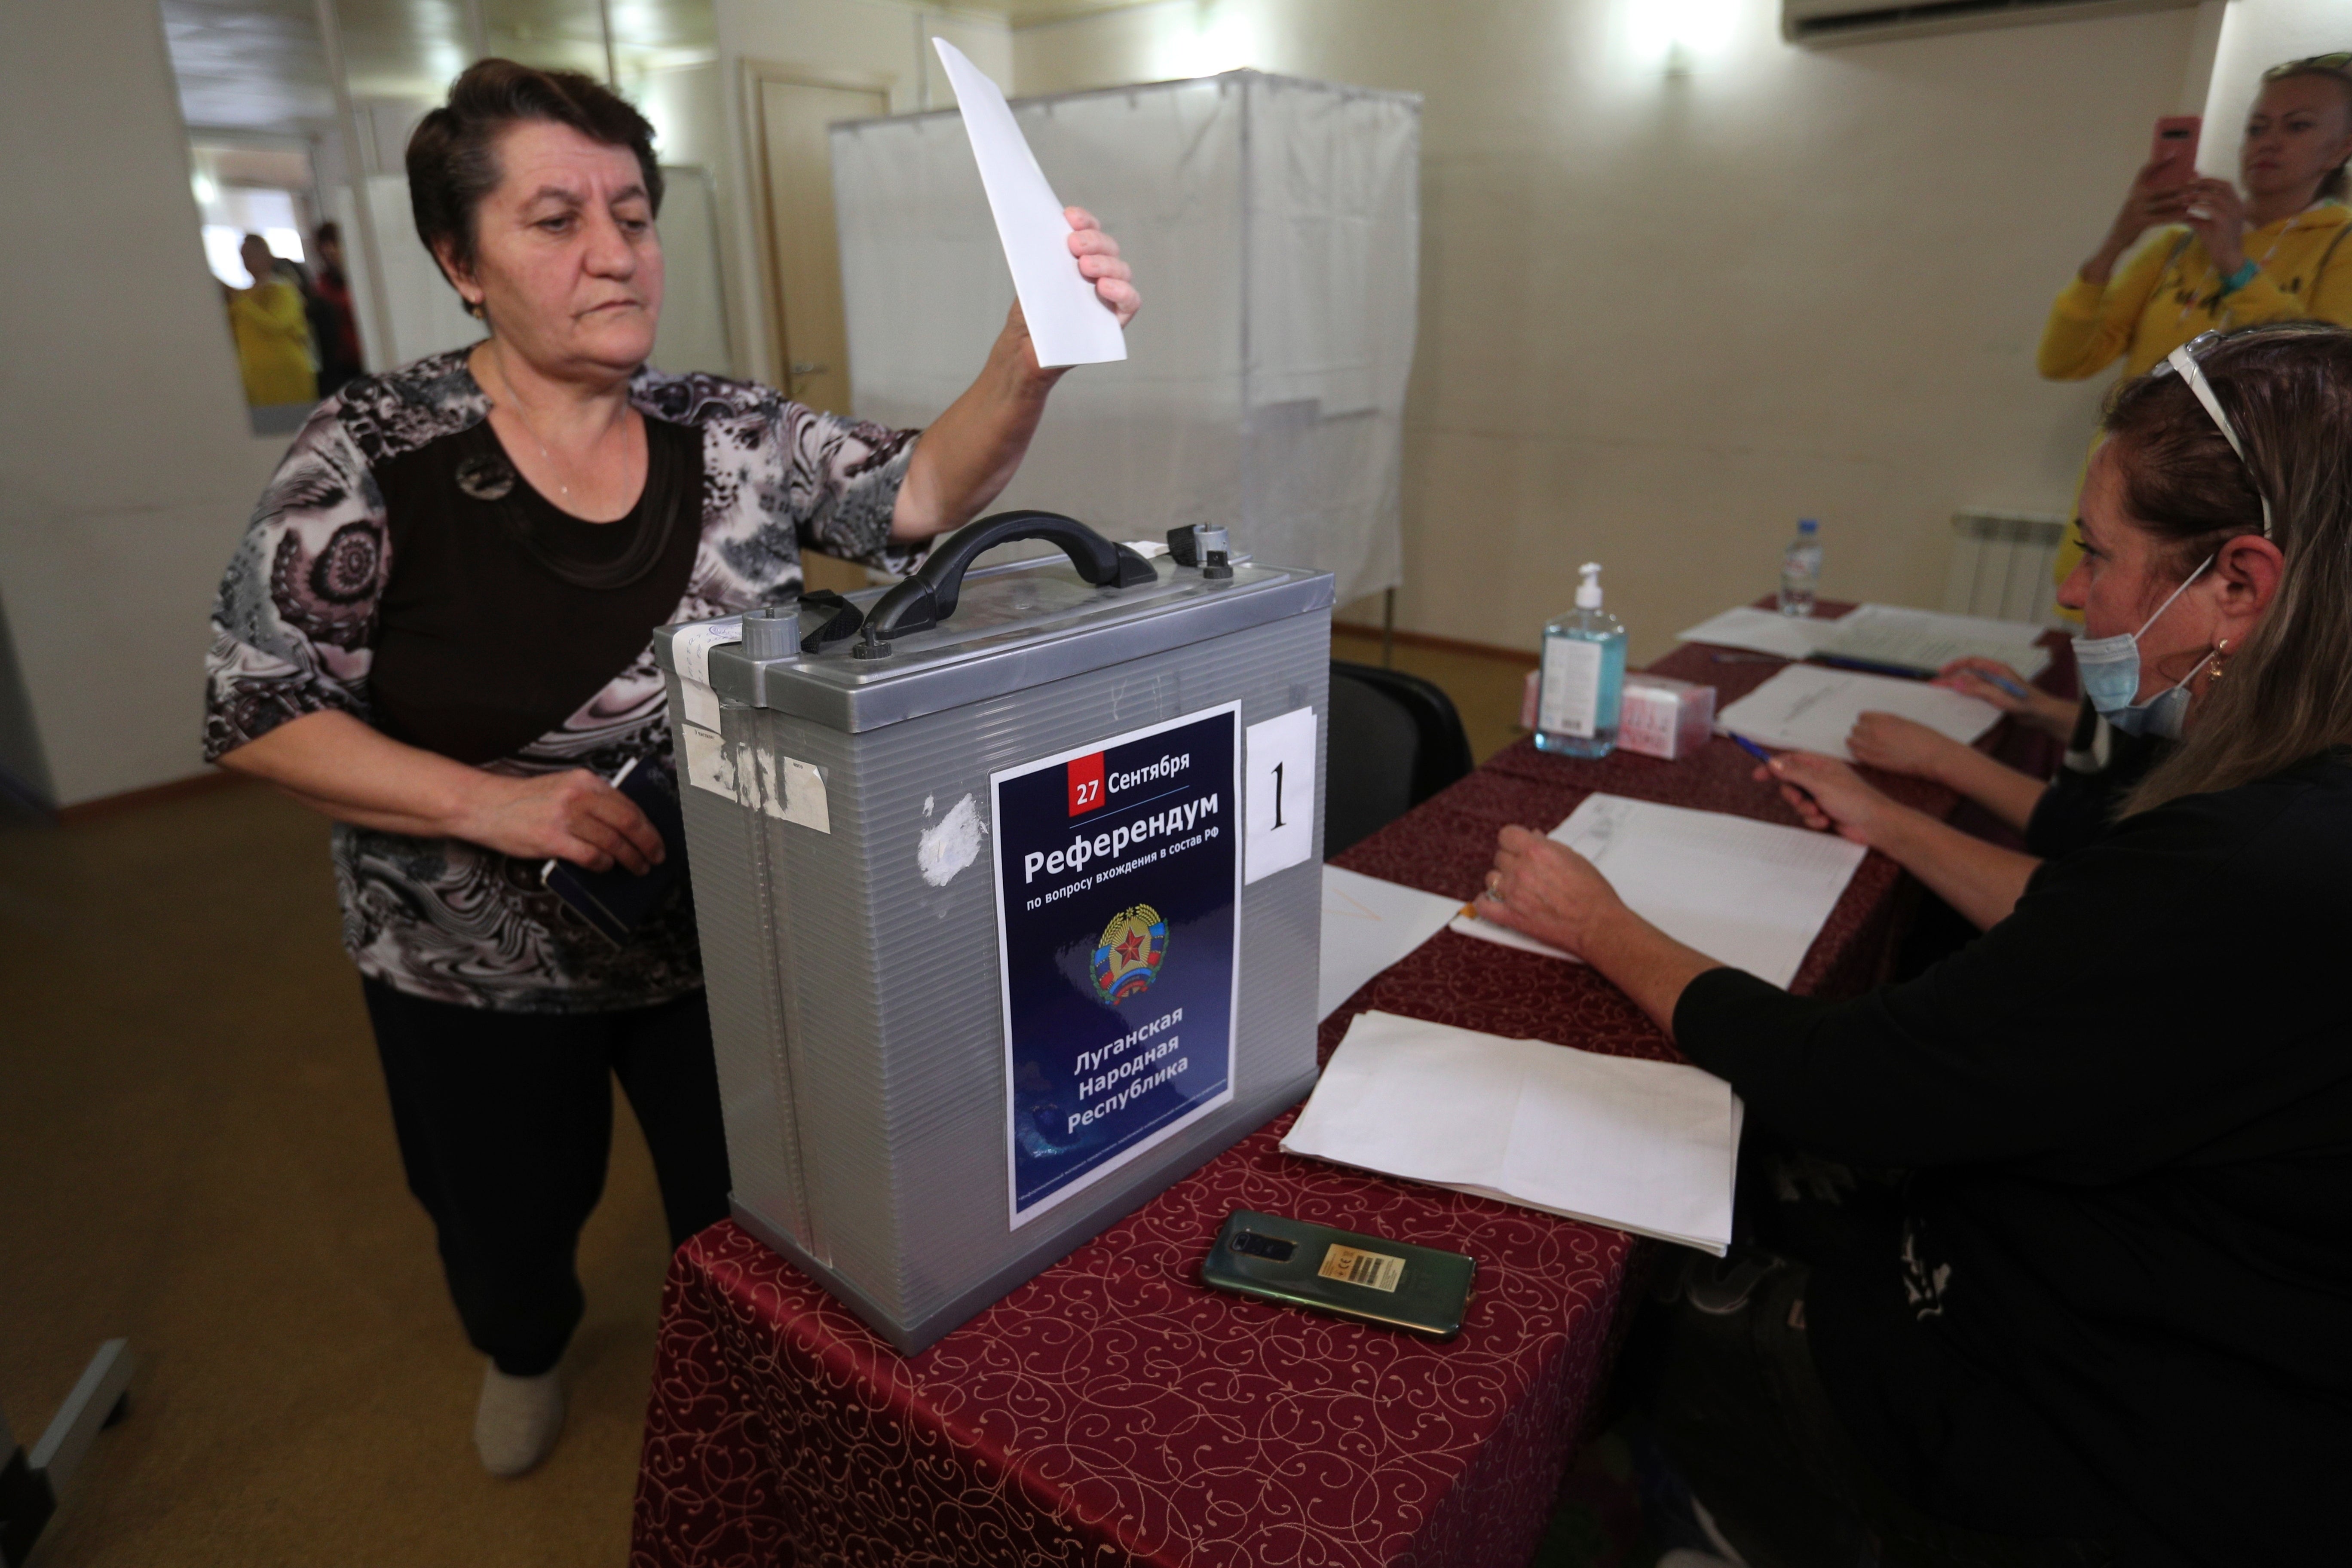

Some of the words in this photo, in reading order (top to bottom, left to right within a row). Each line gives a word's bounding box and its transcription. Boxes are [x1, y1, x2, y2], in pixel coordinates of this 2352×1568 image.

[1077, 779, 1099, 805] 27
[1108, 753, 1190, 793] Сентября
[1271, 761, 1286, 831] 1
[1025, 793, 1219, 884] Референдум
[1027, 897, 1041, 911] по
[1045, 877, 1093, 903] вопросу
[1096, 851, 1157, 883] вхождения
[1160, 848, 1167, 859] в
[1169, 834, 1202, 855] состав
[1205, 826, 1219, 842] РФ
[1074, 1008, 1183, 1076] Луганская
[1079, 1035, 1179, 1101] Народная
[1068, 1057, 1188, 1134] Республика
